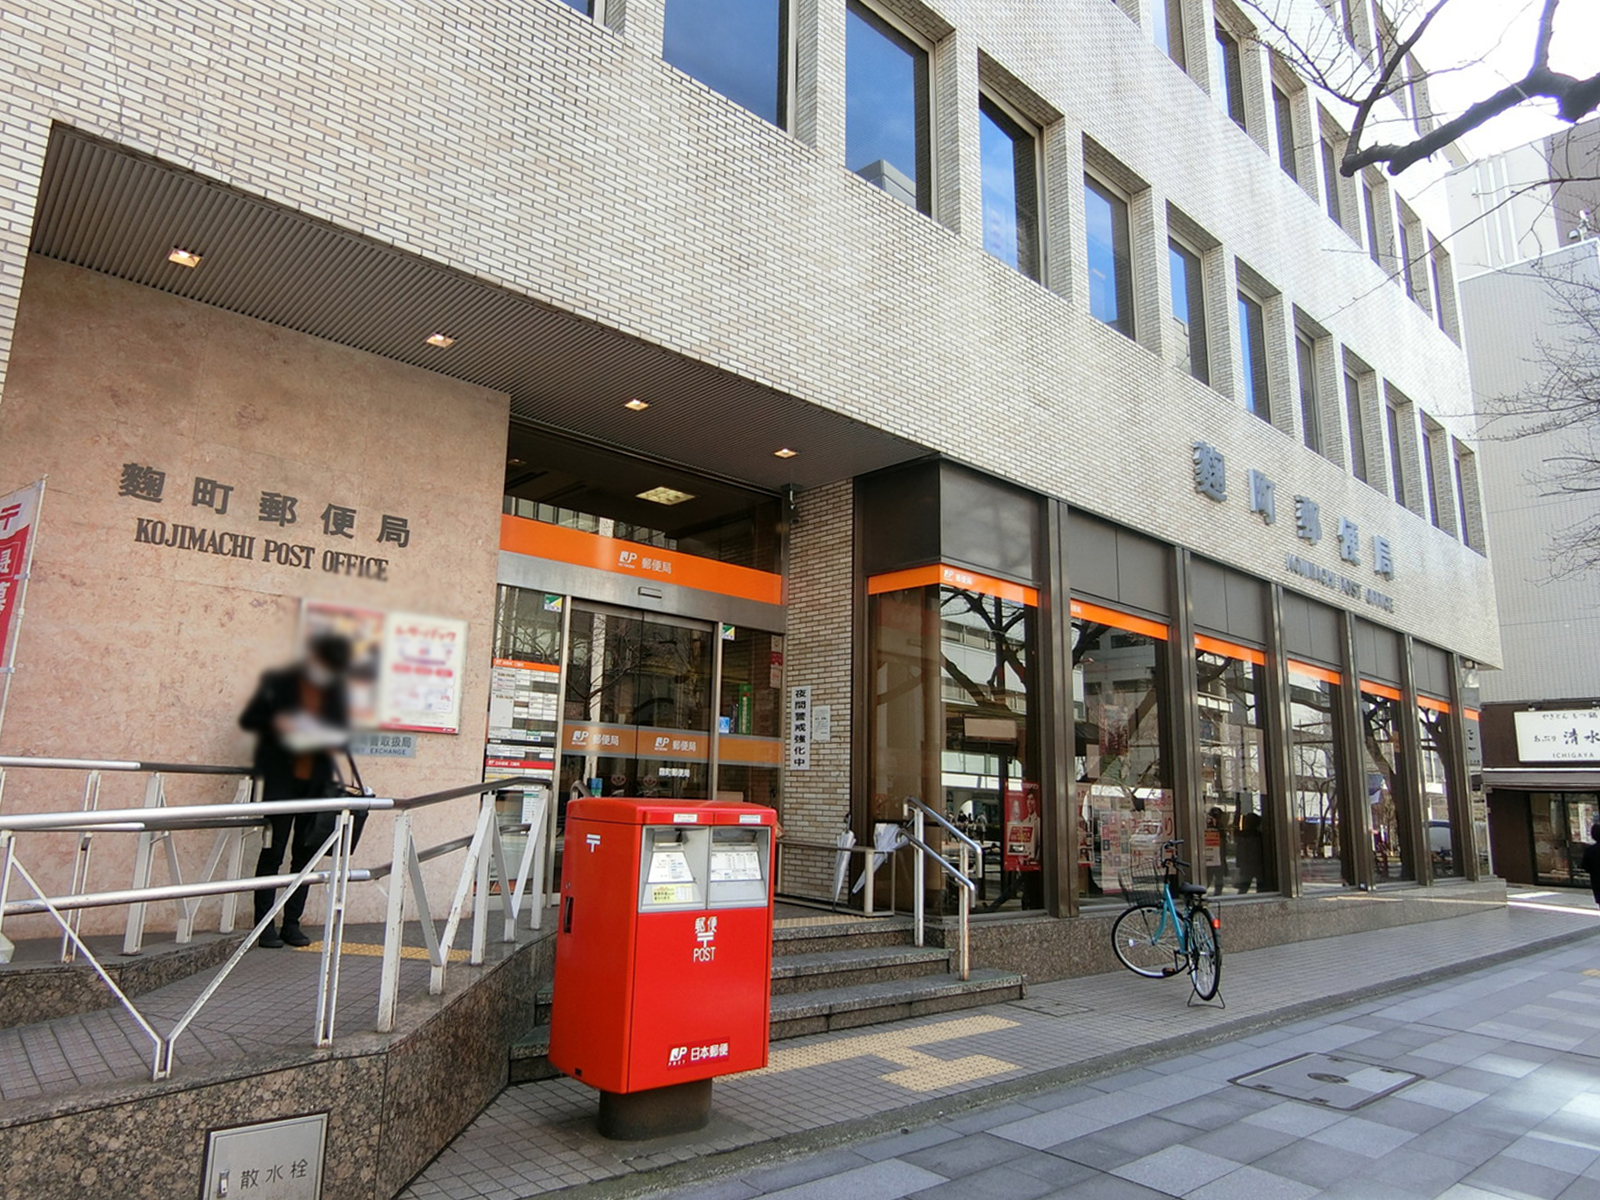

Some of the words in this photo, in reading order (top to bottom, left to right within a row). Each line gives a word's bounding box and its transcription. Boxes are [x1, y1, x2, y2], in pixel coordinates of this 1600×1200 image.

[134, 517, 256, 560] KOJIMACHI
[262, 539, 315, 569] POST
[322, 550, 389, 582] OFFICE
[642, 557, 672, 574] 郵便局
[592, 734, 619, 746] 郵便局
[672, 740, 696, 752] 郵便局
[370, 747, 406, 755] EXCHANGE
[695, 916, 717, 934] 郵便
[693, 947, 716, 962] POST
[691, 1043, 728, 1061] 日本郵便
[240, 1158, 309, 1190] 散水栓
